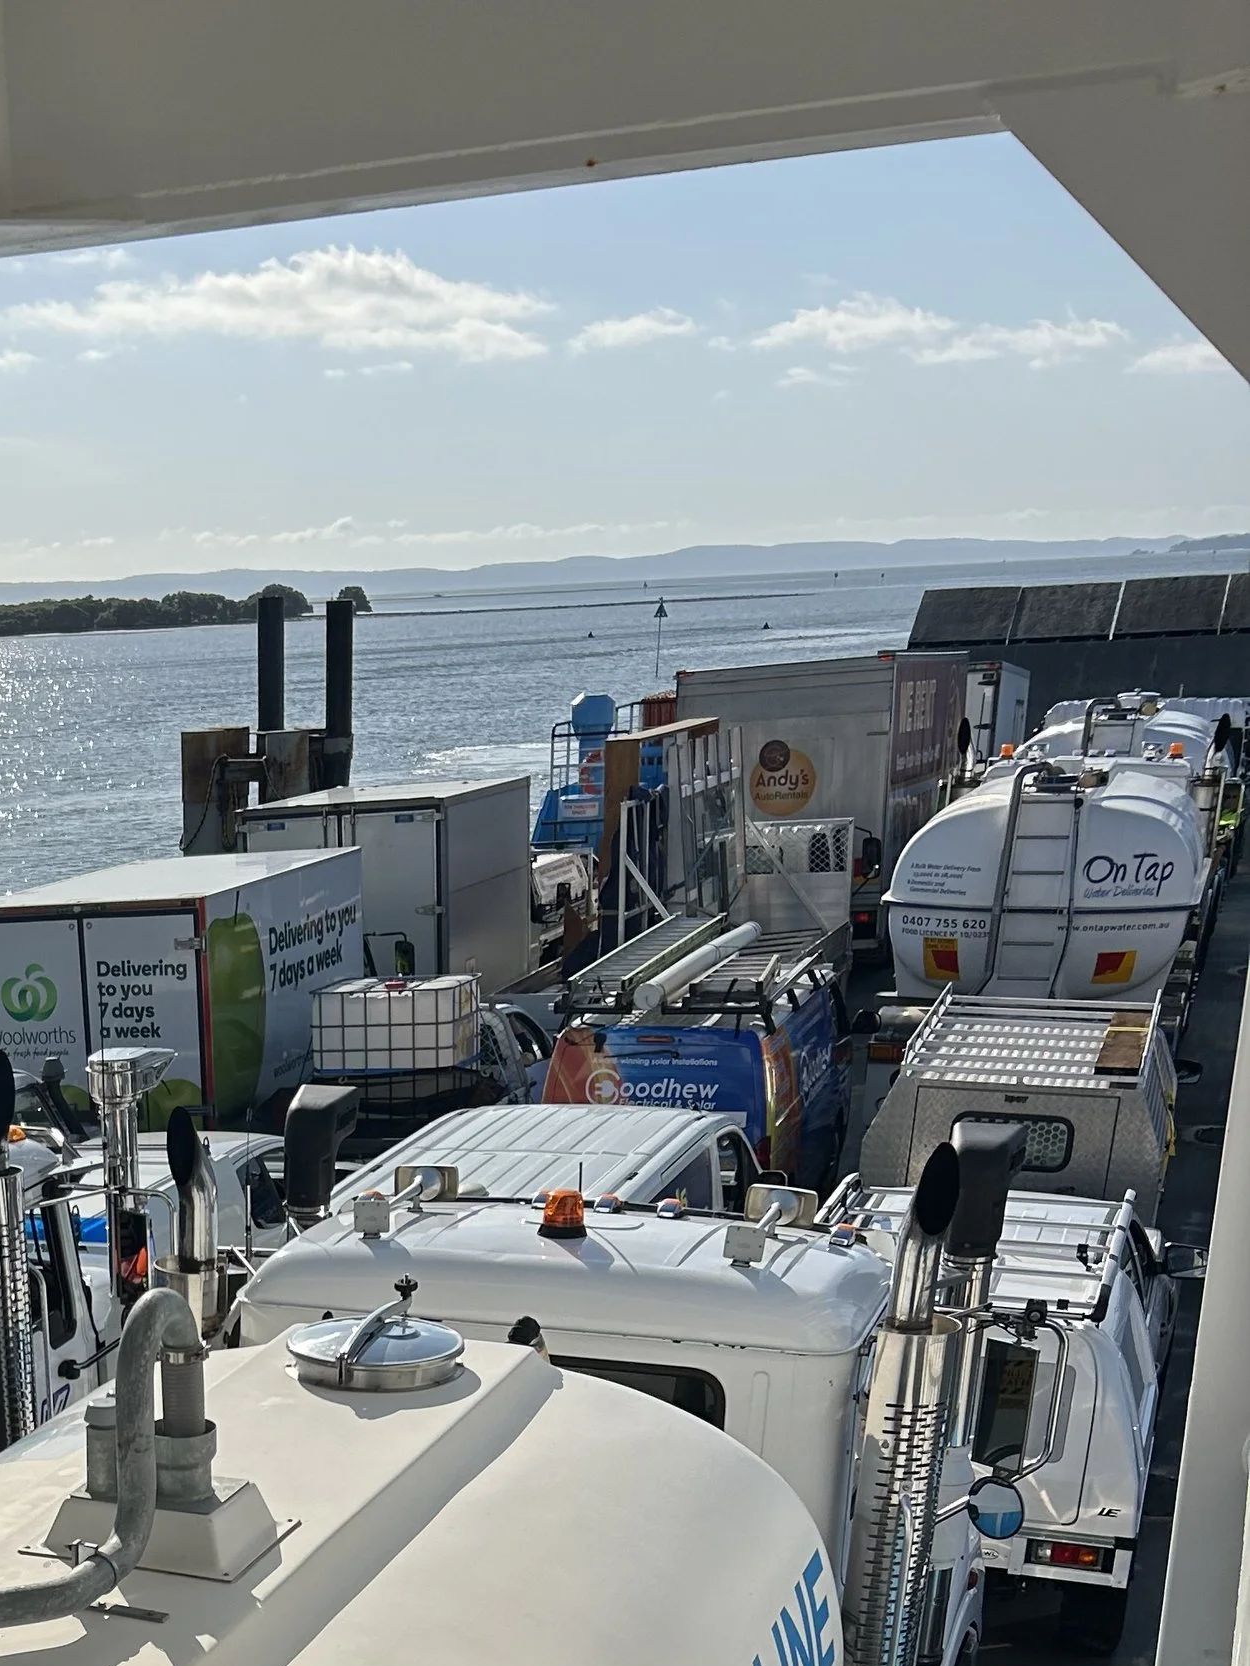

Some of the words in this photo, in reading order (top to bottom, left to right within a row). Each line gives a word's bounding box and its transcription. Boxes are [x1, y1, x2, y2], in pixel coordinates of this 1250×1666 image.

[755, 769, 809, 791] Andy's
[1082, 855, 1127, 883] On
[1133, 853, 1174, 897] Tap
[1084, 887, 1110, 898] Water
[1113, 884, 1155, 897] Deliveries
[268, 913, 324, 957] Delivering
[324, 909, 337, 934] to
[337, 904, 357, 937] you
[902, 915, 931, 927] 0407
[935, 918, 958, 928] 755
[962, 919, 986, 929] 620
[902, 928, 919, 936] FOOD
[919, 929, 948, 937] LICENCE
[96, 959, 188, 981] Delivering
[269, 962, 278, 992] 7
[279, 959, 306, 991] days
[307, 961, 315, 976] a
[315, 938, 343, 972] week
[97, 981, 116, 997] to
[120, 983, 153, 1001] you
[99, 1003, 109, 1019] 7
[112, 1002, 155, 1023] days
[100, 1026, 111, 1039] a
[115, 1022, 161, 1039] week
[651, 1057, 669, 1065] solar
[672, 1057, 718, 1066] installations
[586, 1069, 719, 1105] Goodhew
